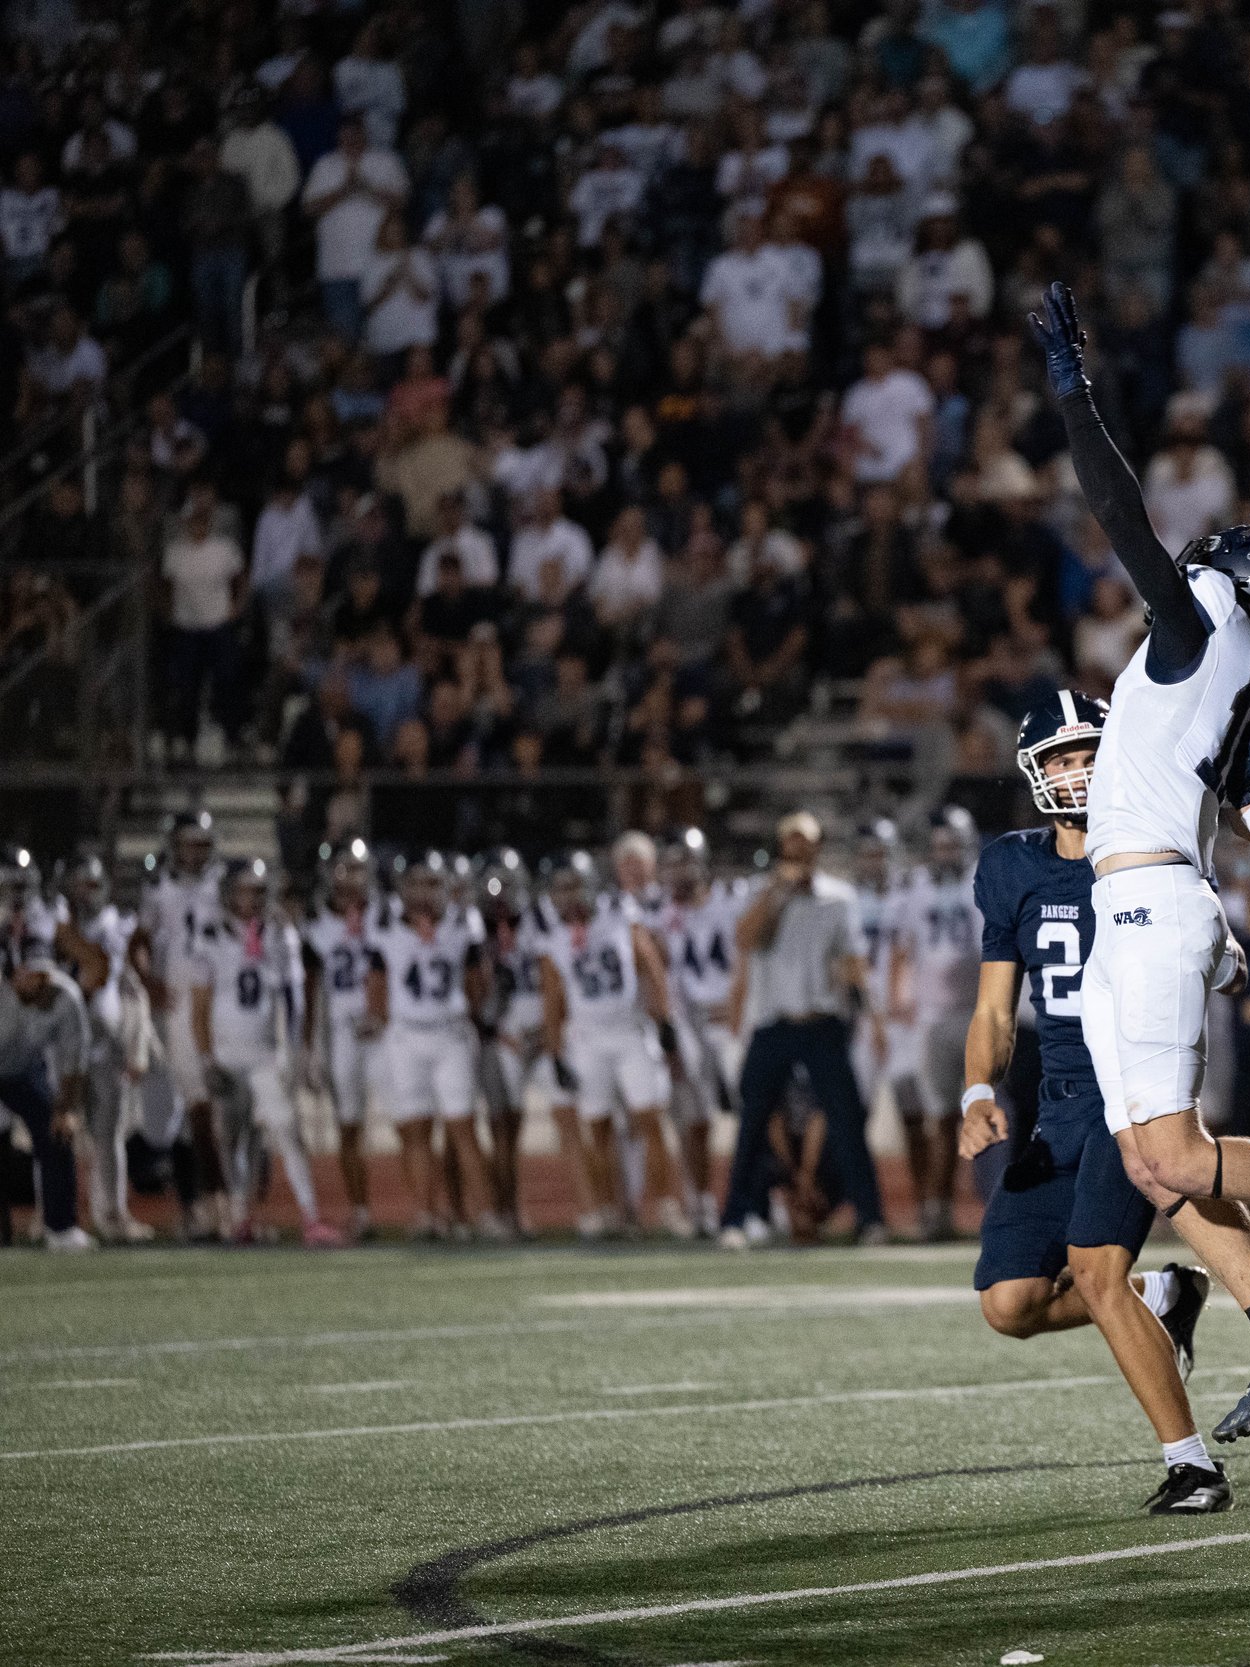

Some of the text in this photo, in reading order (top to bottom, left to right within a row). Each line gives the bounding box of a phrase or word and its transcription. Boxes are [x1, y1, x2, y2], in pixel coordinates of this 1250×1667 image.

[1060, 723, 1091, 733] Riddell
[1040, 904, 1080, 920] RANGERS
[1036, 921, 1084, 1018] 2
